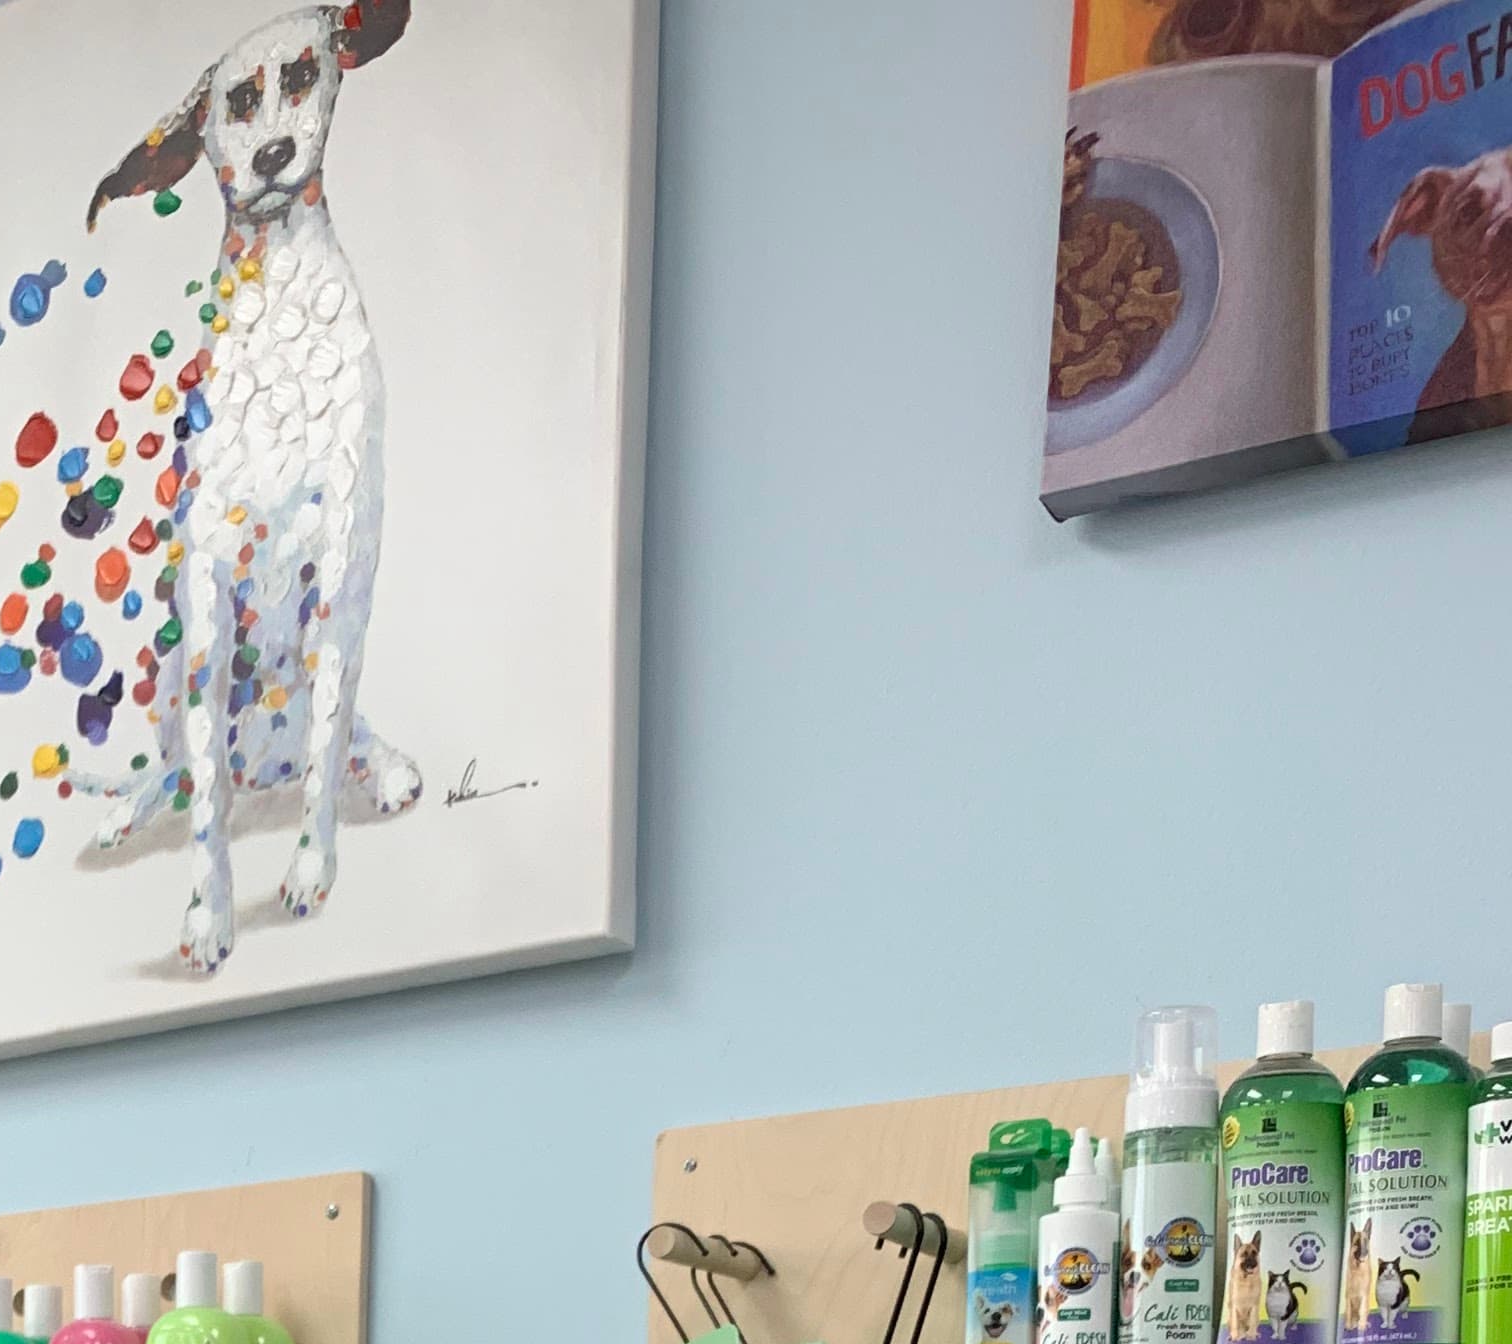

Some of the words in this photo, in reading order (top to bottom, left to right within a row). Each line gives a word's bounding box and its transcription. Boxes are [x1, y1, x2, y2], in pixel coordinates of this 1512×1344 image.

[1385, 303, 1412, 329] 10
[1348, 1148, 1423, 1175] ProCare
[1231, 1162, 1310, 1190] ProCare
[1369, 1174, 1449, 1193] SOLUTION
[1256, 1189, 1330, 1207] SOLUTION
[1143, 1303, 1179, 1323] Cali
